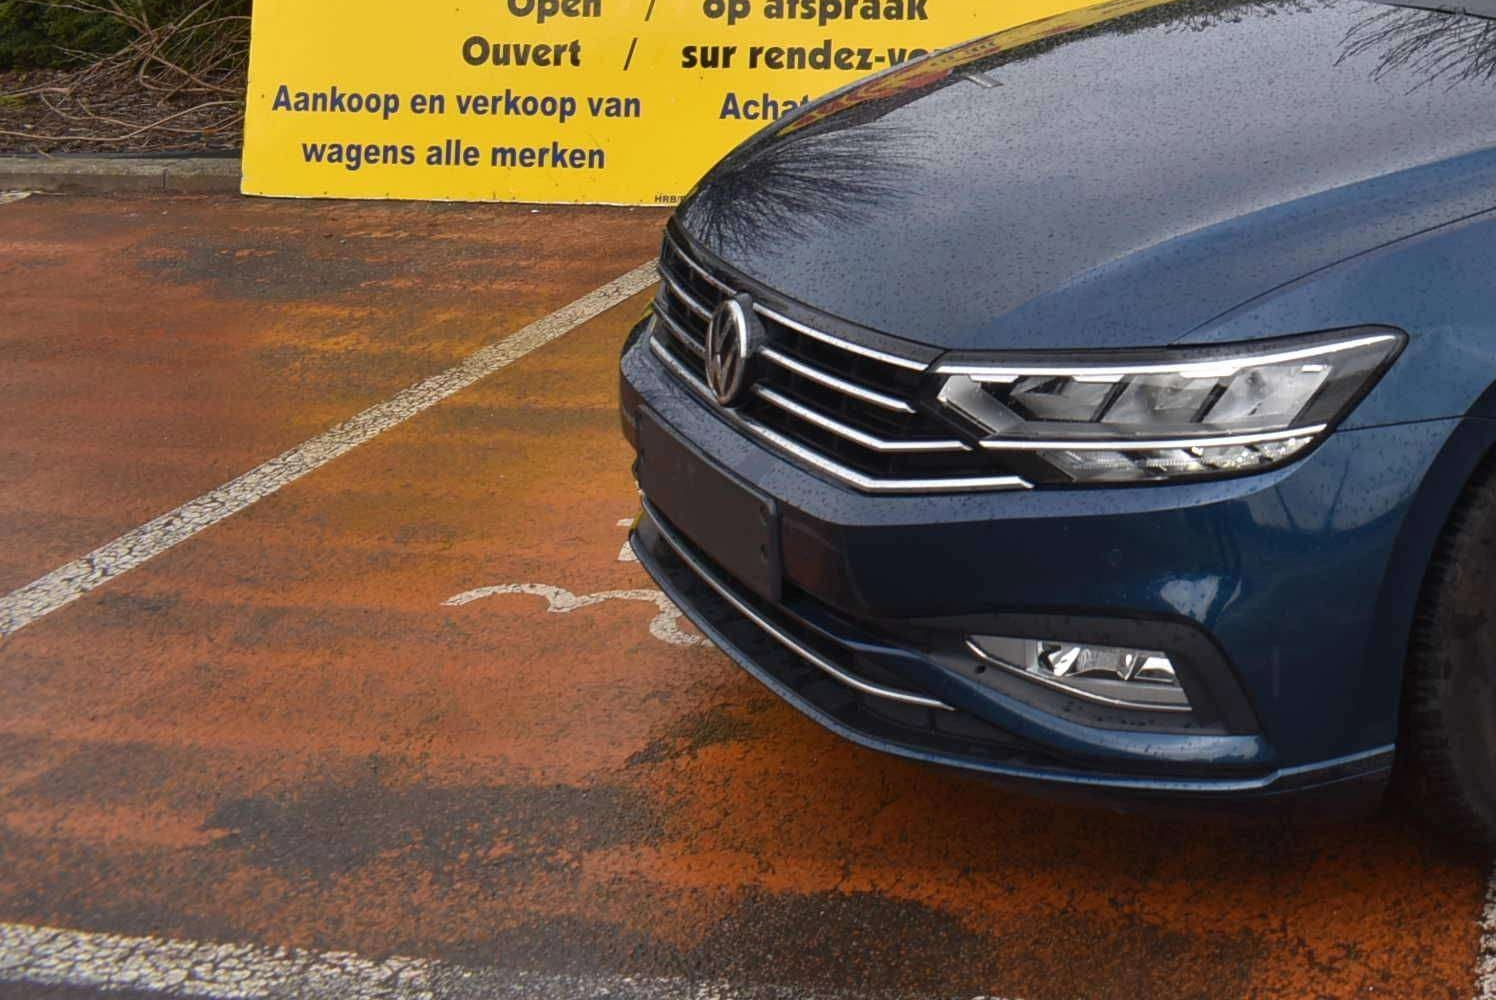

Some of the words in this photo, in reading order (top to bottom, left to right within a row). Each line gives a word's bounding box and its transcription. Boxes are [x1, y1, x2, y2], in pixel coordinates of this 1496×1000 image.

[462, 35, 581, 67] Ouvert
[681, 45, 737, 69] sur
[271, 84, 400, 121] Aankoop
[410, 94, 445, 114] en
[455, 88, 577, 124] verkoop
[587, 97, 641, 118] van
[302, 143, 416, 171] wagens
[425, 139, 480, 167] alle
[491, 141, 605, 170] merken
